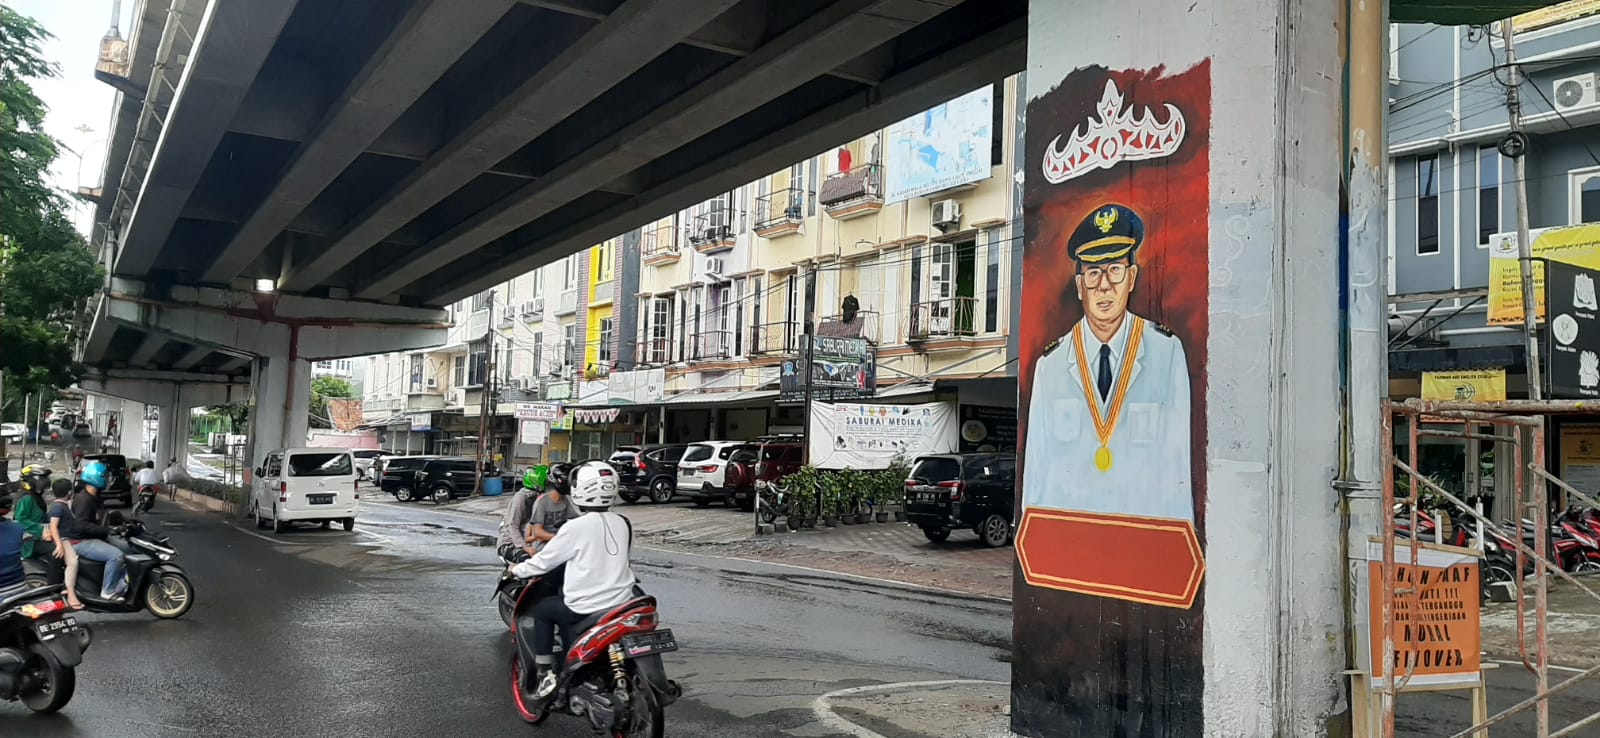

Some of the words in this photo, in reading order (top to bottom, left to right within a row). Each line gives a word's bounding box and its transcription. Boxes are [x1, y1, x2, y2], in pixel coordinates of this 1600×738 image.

[846, 416, 884, 425] SABURAI
[888, 417, 922, 426] MEDIKA
[1421, 601, 1463, 610] TERGANGGU
